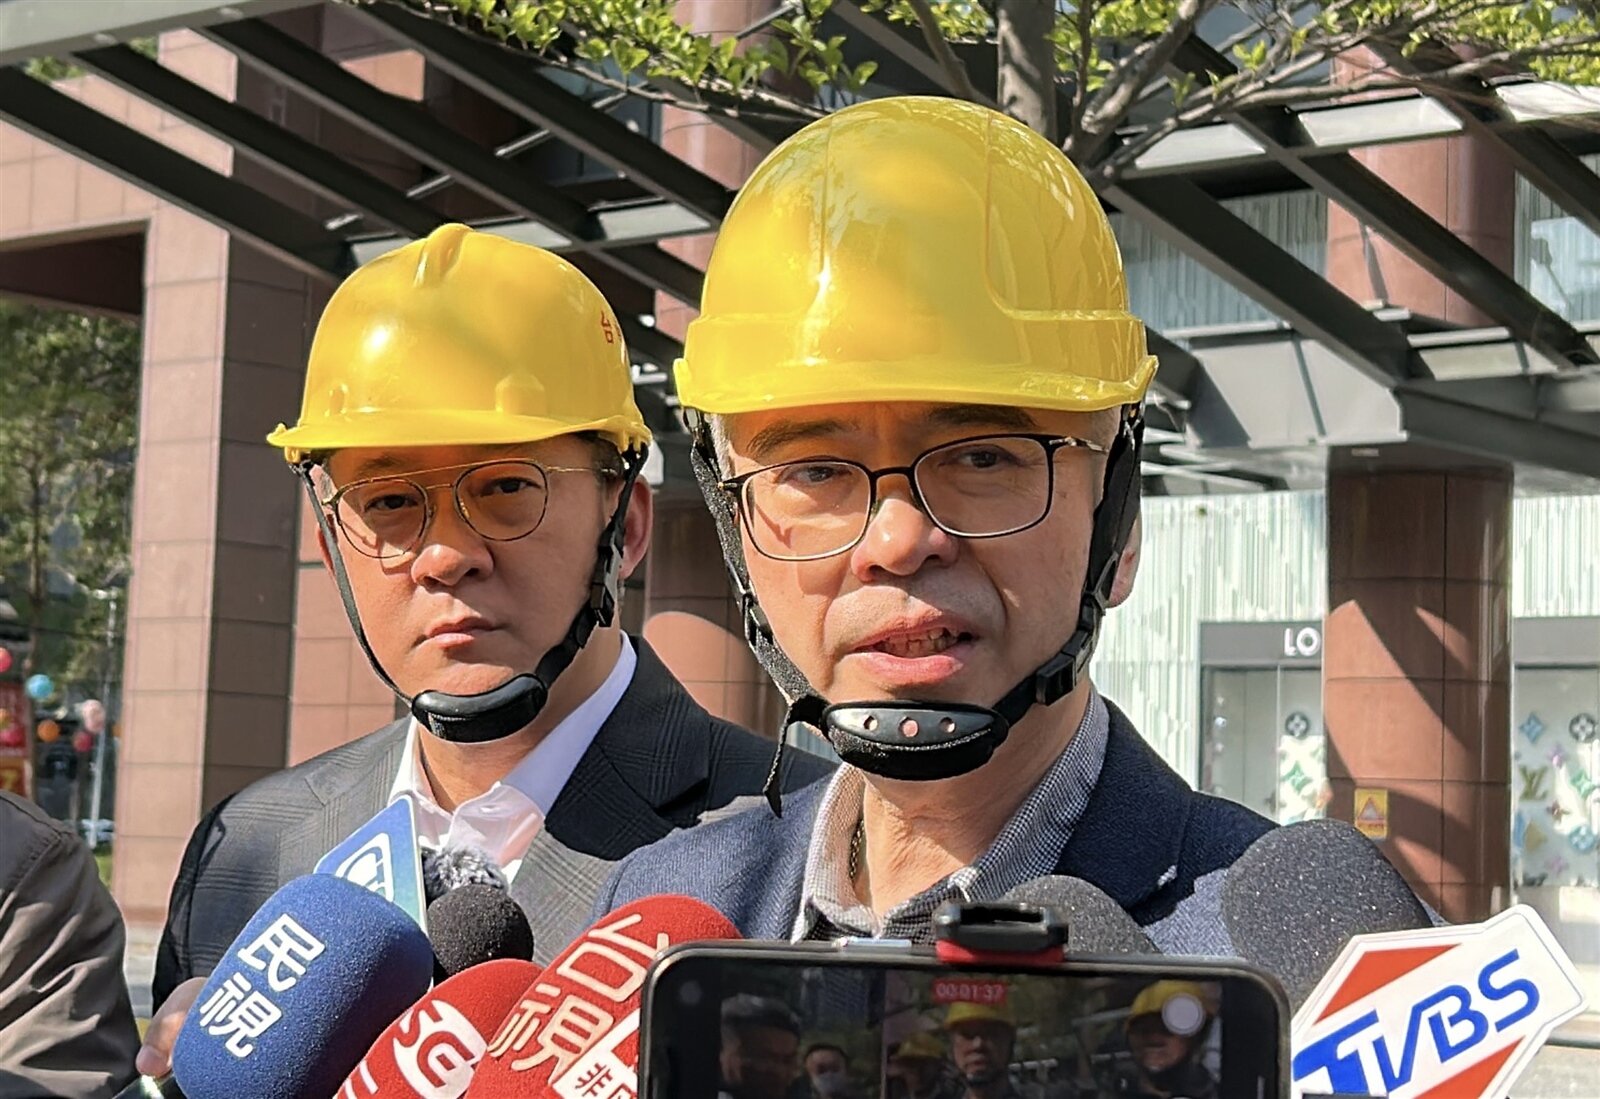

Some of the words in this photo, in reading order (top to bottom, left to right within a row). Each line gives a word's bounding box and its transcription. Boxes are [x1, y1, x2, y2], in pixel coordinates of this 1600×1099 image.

[1284, 627, 1321, 656] LO
[200, 913, 326, 1058] 民視
[487, 913, 670, 1088] 台視
[1293, 948, 1540, 1095] TVBS
